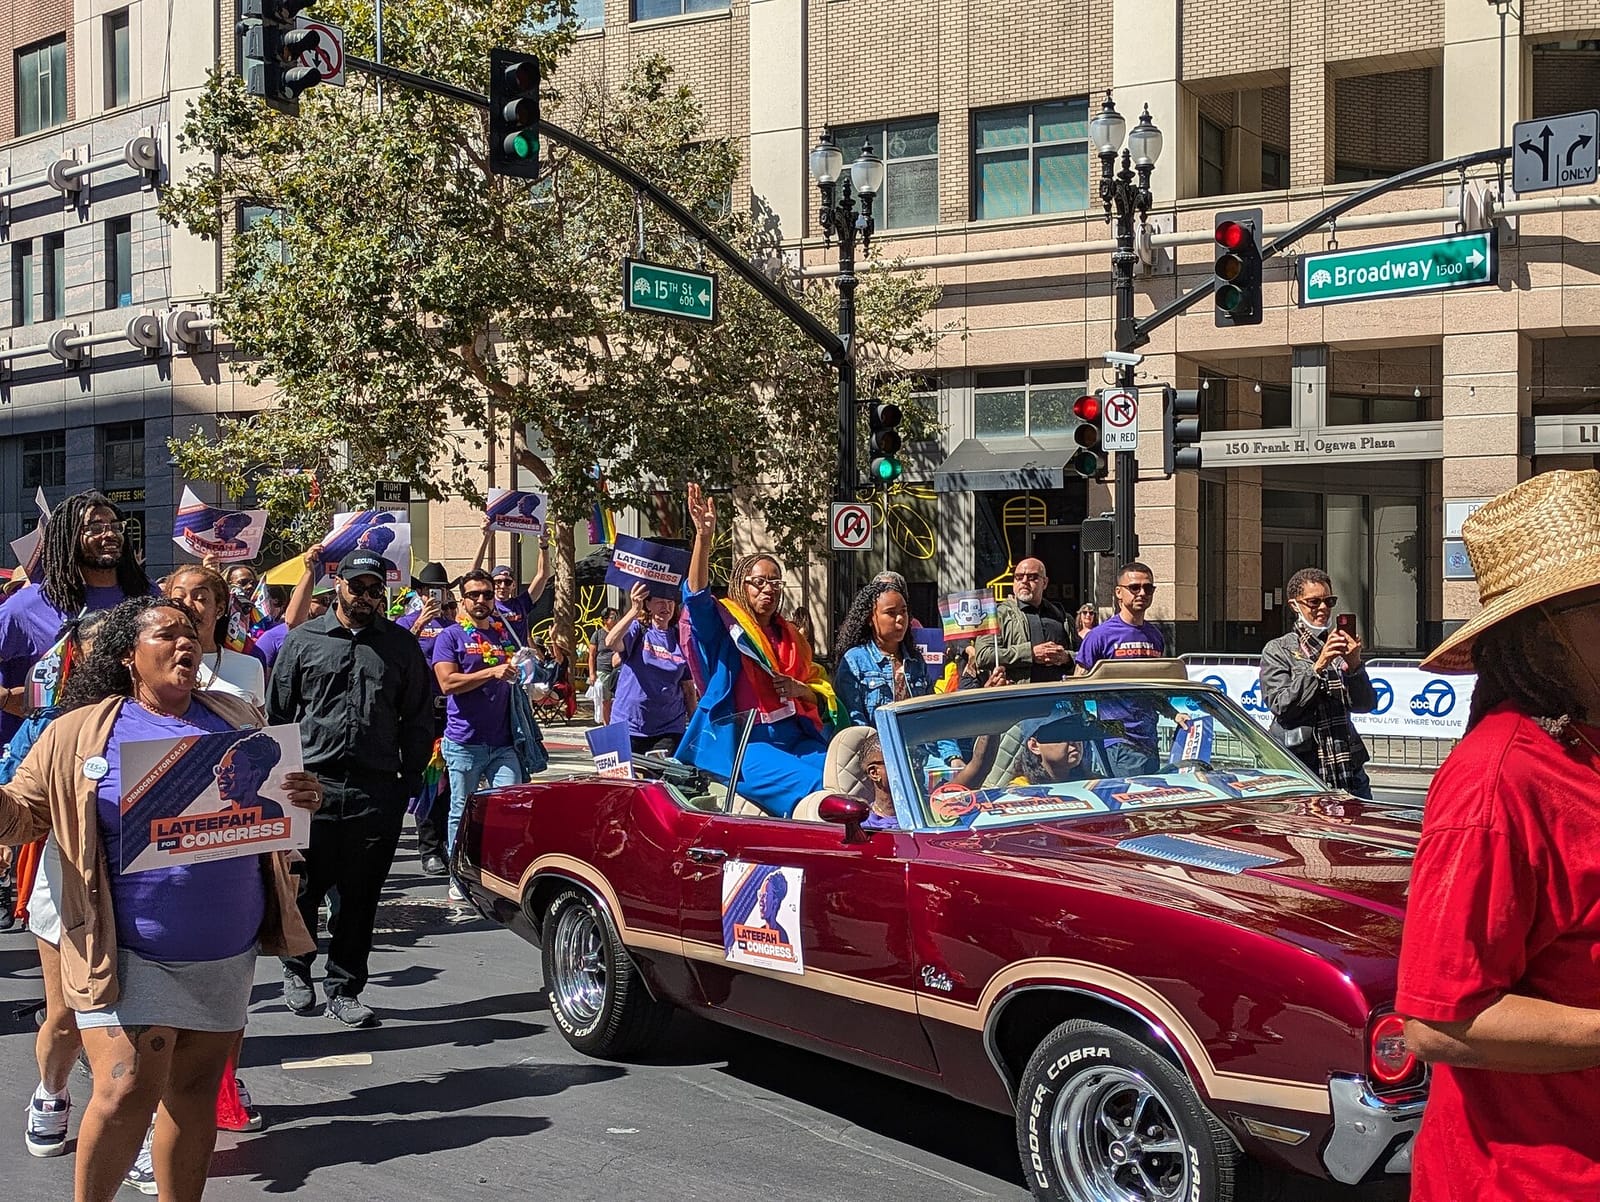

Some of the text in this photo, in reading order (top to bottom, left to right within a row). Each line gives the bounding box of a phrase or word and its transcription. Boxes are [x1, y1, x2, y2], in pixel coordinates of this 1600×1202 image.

[1561, 167, 1592, 182] ONLY
[1335, 259, 1463, 287] Broadway 1500
[655, 280, 692, 300] 15TH St
[680, 296, 695, 307] 600
[1106, 432, 1135, 443] ON RED
[1225, 442, 1249, 455] 150
[1253, 441, 1290, 454] Frank
[1314, 439, 1356, 453] Ogawa
[1360, 437, 1395, 449] Plaza
[108, 490, 131, 501] COFFEE
[383, 482, 402, 491] RIGHT
[384, 492, 401, 501] LANE
[353, 557, 381, 568] SECURITY
[617, 552, 667, 573] LATEEFAH
[627, 563, 678, 583] CONGRESS
[1410, 697, 1430, 709] abc
[1404, 718, 1430, 726] WHERE
[126, 769, 160, 804] DEMOCRAT
[159, 759, 172, 773] FOR
[1005, 802, 1088, 815] CONGRESS
[157, 812, 256, 837] LATEEFAH
[160, 821, 285, 849] FOR CONGRESS
[550, 890, 579, 916] RADIAL
[737, 927, 777, 944] LATEEFAH
[746, 941, 792, 959] CONGRESS
[549, 992, 574, 1034] COBRA
[1028, 1046, 1111, 1189] COOPER COBRA
